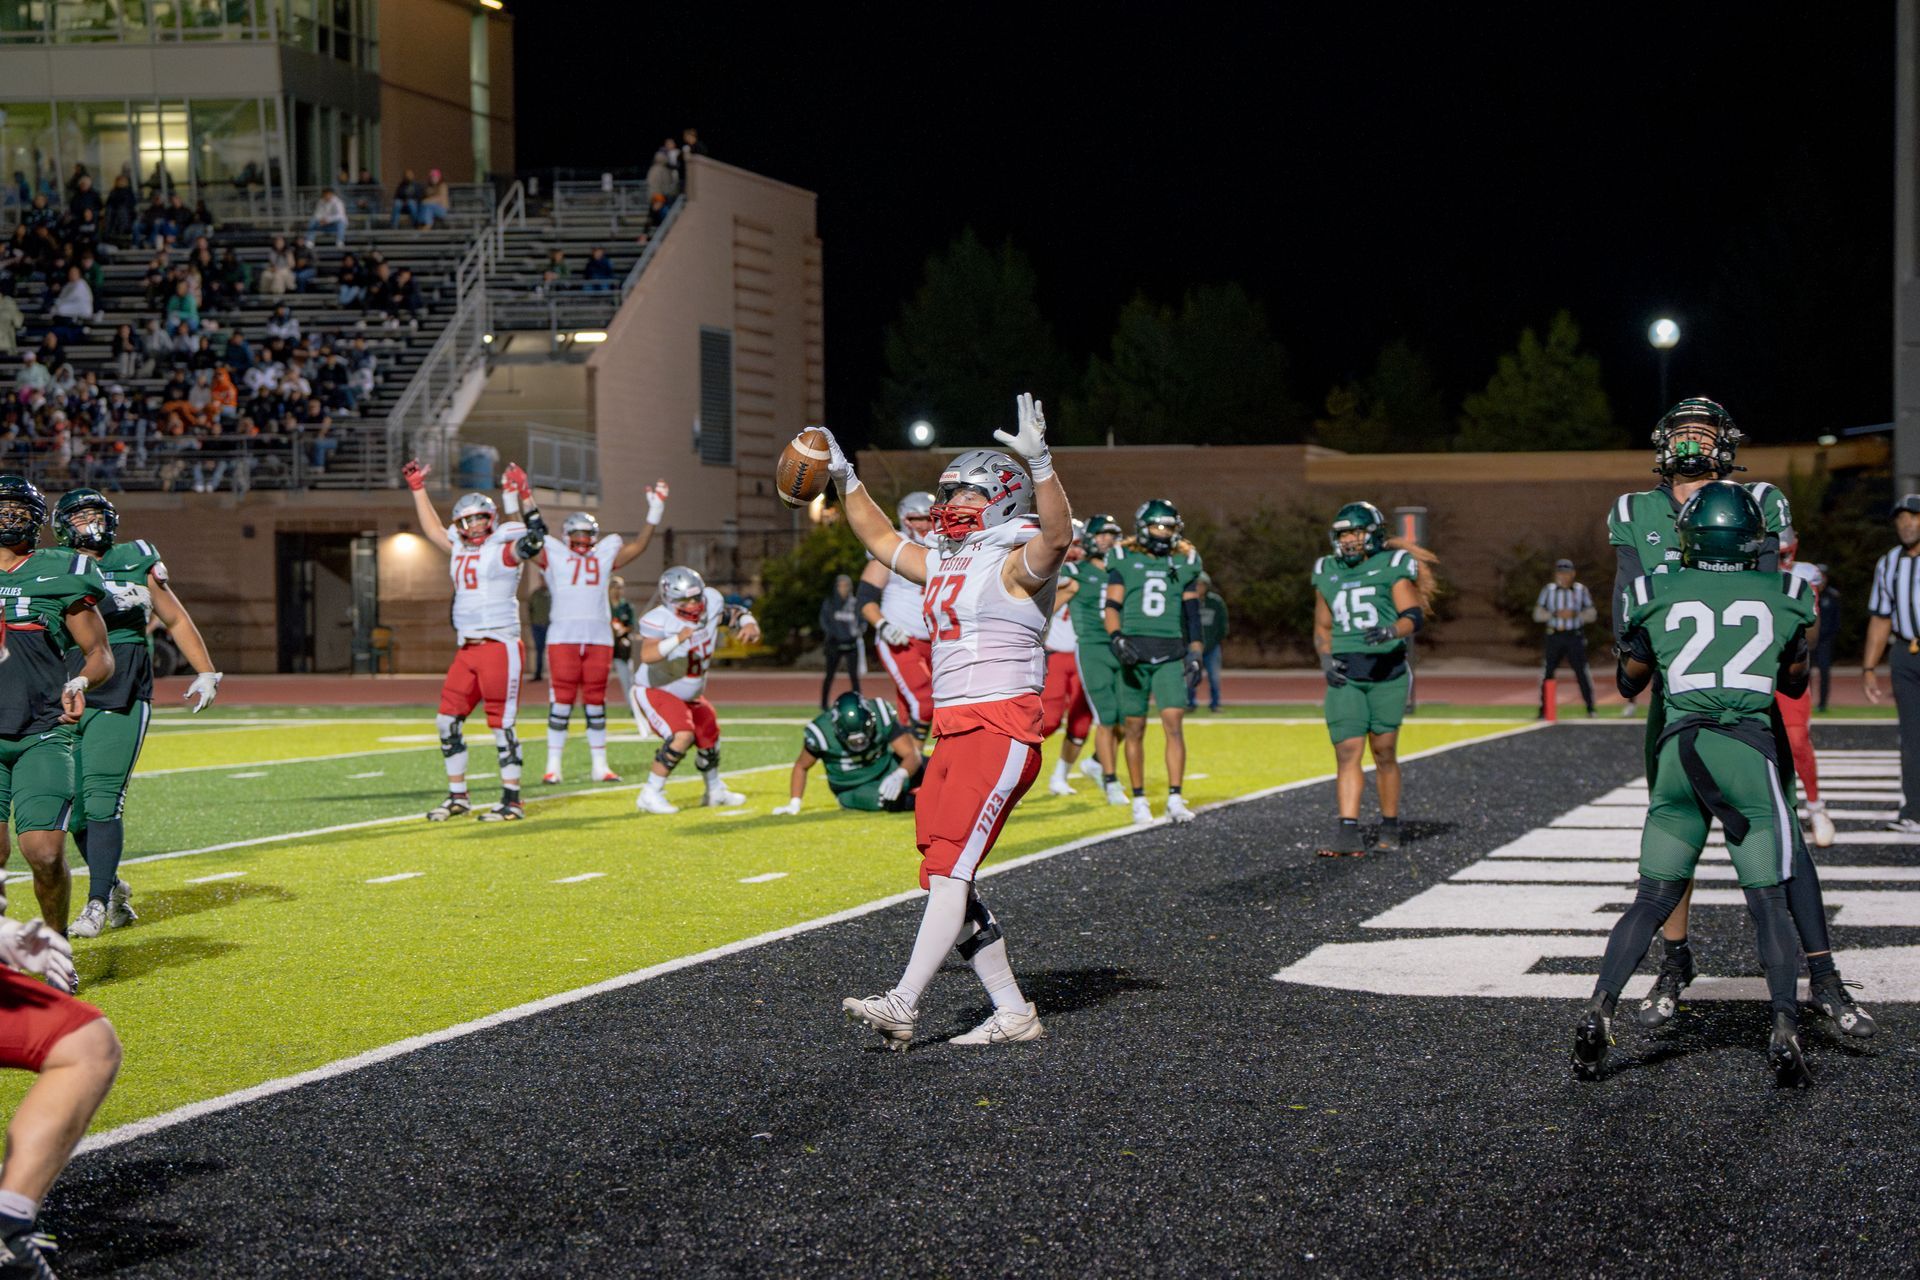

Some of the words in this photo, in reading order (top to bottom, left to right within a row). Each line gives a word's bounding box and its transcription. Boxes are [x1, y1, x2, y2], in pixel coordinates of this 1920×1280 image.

[454, 555, 480, 590] 76
[567, 555, 600, 586] 79
[1697, 559, 1744, 573] Riddell
[922, 573, 967, 643] 83
[1142, 578, 1168, 617] 6
[1332, 586, 1379, 632] 45
[1665, 599, 1774, 695] 22
[976, 792, 1004, 836] 7723
